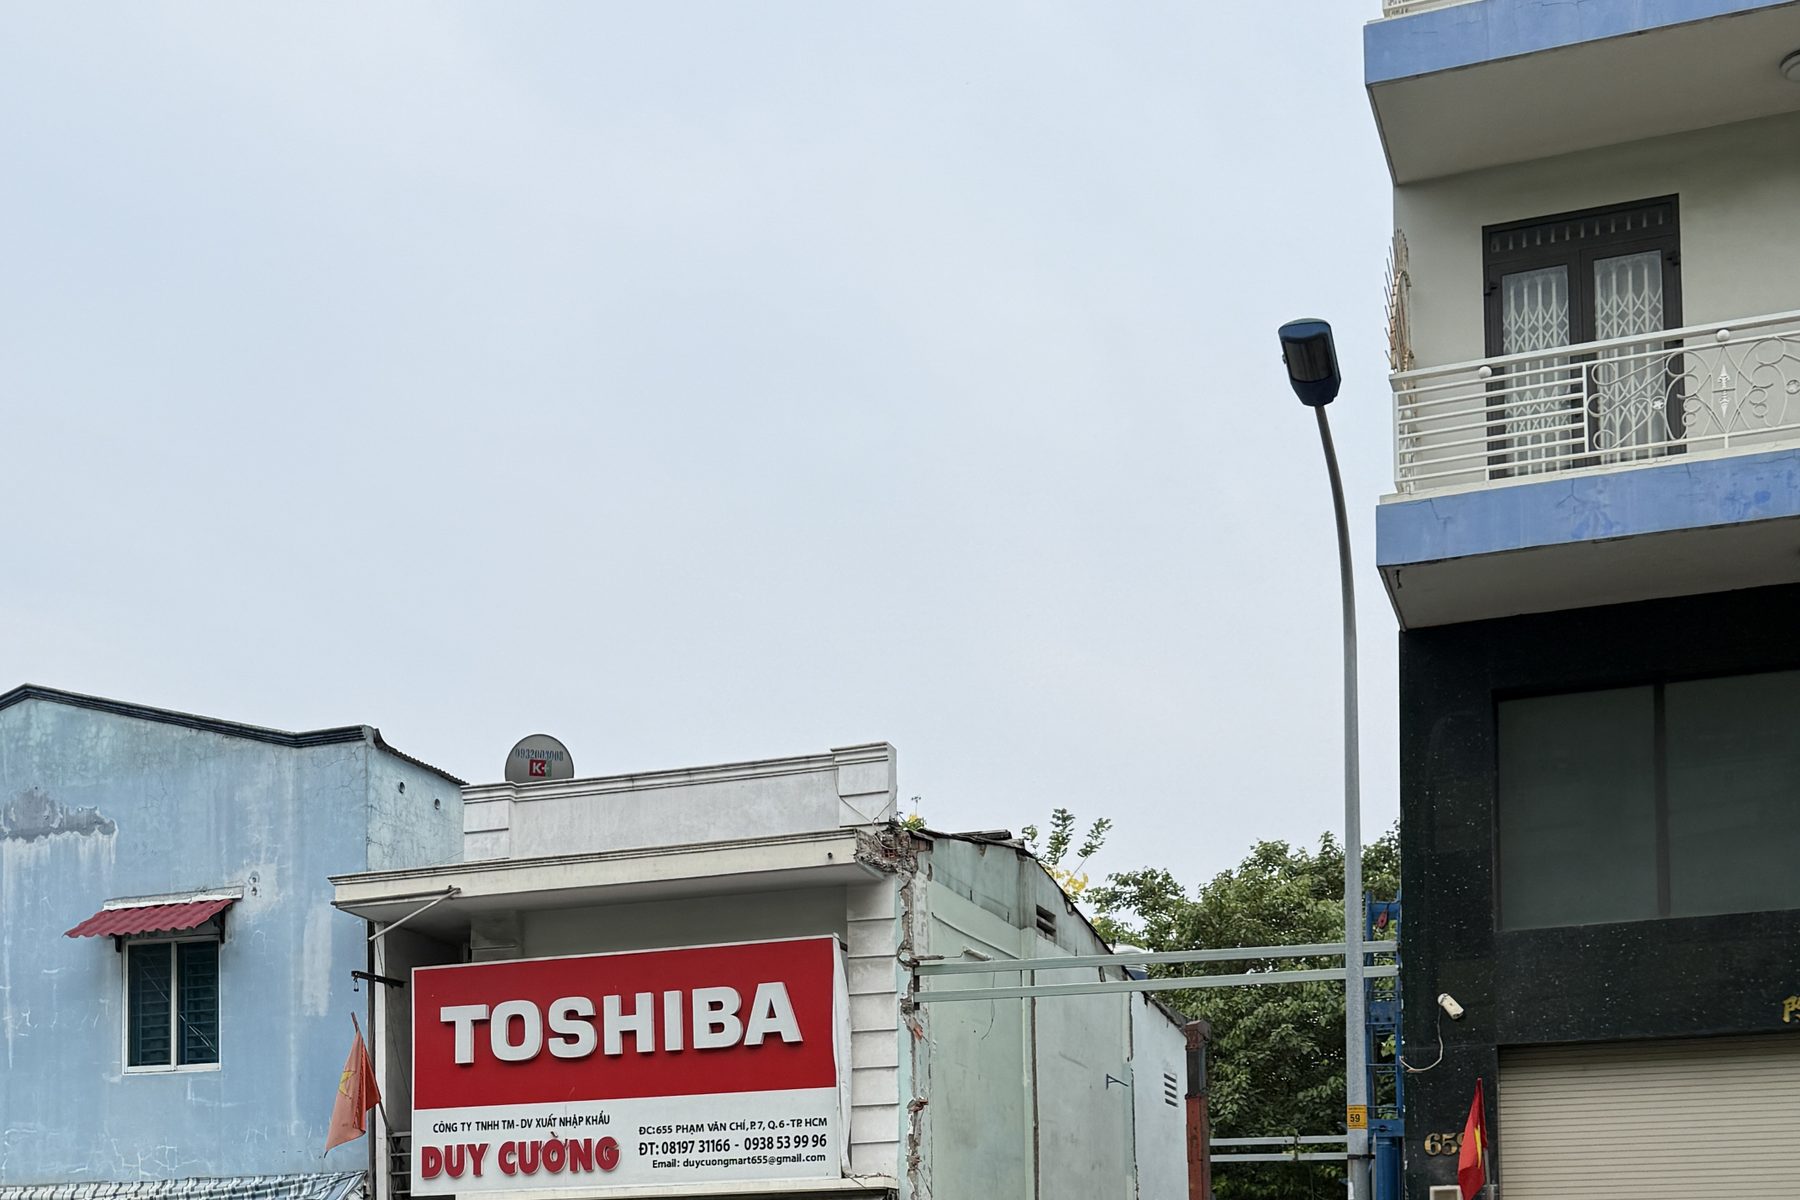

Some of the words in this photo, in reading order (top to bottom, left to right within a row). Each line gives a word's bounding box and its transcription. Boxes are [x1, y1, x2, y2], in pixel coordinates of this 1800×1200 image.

[440, 981, 803, 1065] TOSHIBA
[433, 1120, 457, 1133] CÔNG
[460, 1121, 472, 1131] TY
[475, 1120, 499, 1131] TNHH
[535, 1113, 557, 1128] XUẤT
[559, 1113, 584, 1129] NHẬP
[675, 1123, 704, 1135] PHẠM
[707, 1121, 727, 1132] VĂN
[804, 1117, 827, 1127] HCM
[1349, 1113, 1361, 1123] 59
[638, 1142, 659, 1156] ĐT:
[661, 1140, 695, 1154] 08197
[698, 1139, 730, 1153] 31166
[744, 1136, 774, 1150] 0938
[776, 1135, 791, 1149] 53
[793, 1135, 809, 1148] 99
[811, 1134, 827, 1147] 96
[1424, 1132, 1465, 1156] 65
[421, 1143, 490, 1180] DUY
[497, 1131, 621, 1177] CƯỜNG
[652, 1159, 680, 1168] Email:
[682, 1153, 826, 1168] duycuongmart655@gmail.com
